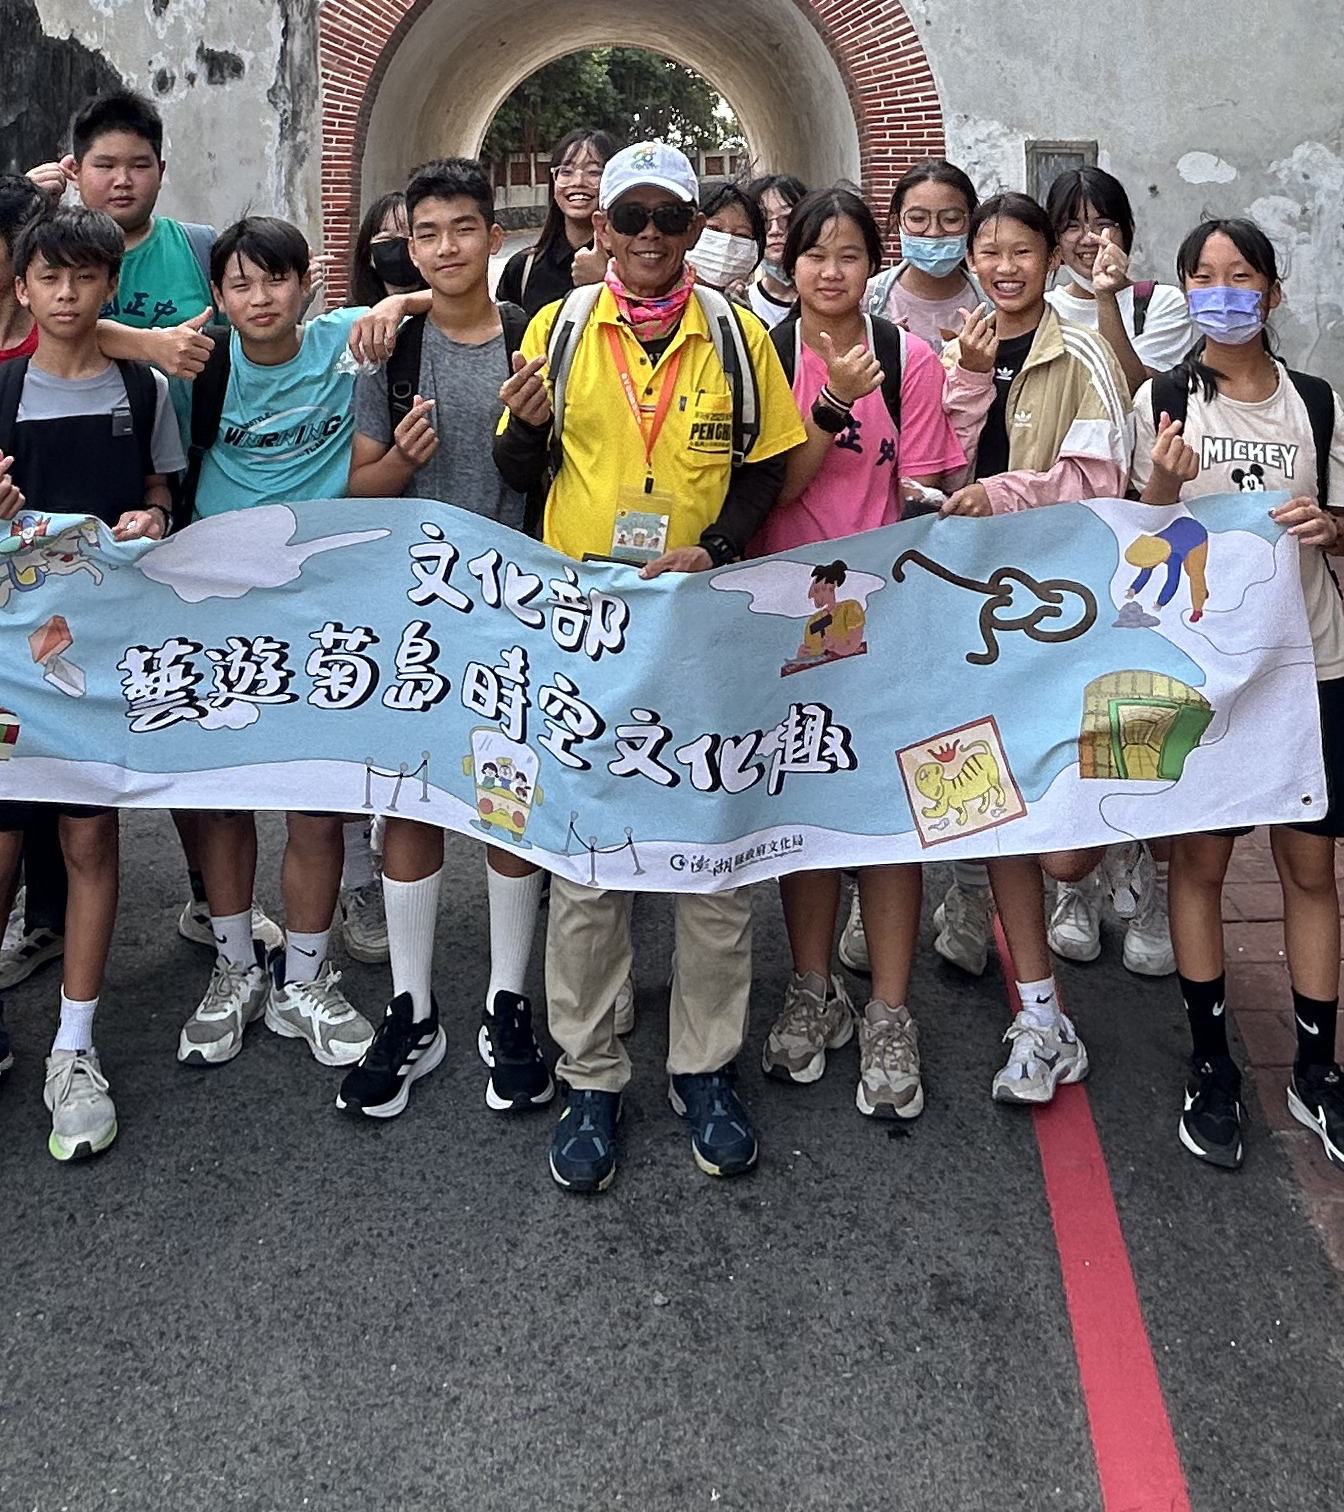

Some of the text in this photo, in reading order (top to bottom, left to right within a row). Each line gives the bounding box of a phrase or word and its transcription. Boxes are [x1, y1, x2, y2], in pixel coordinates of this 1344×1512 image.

[1202, 435, 1298, 479] MICKEY
[407, 521, 631, 661] 文化部
